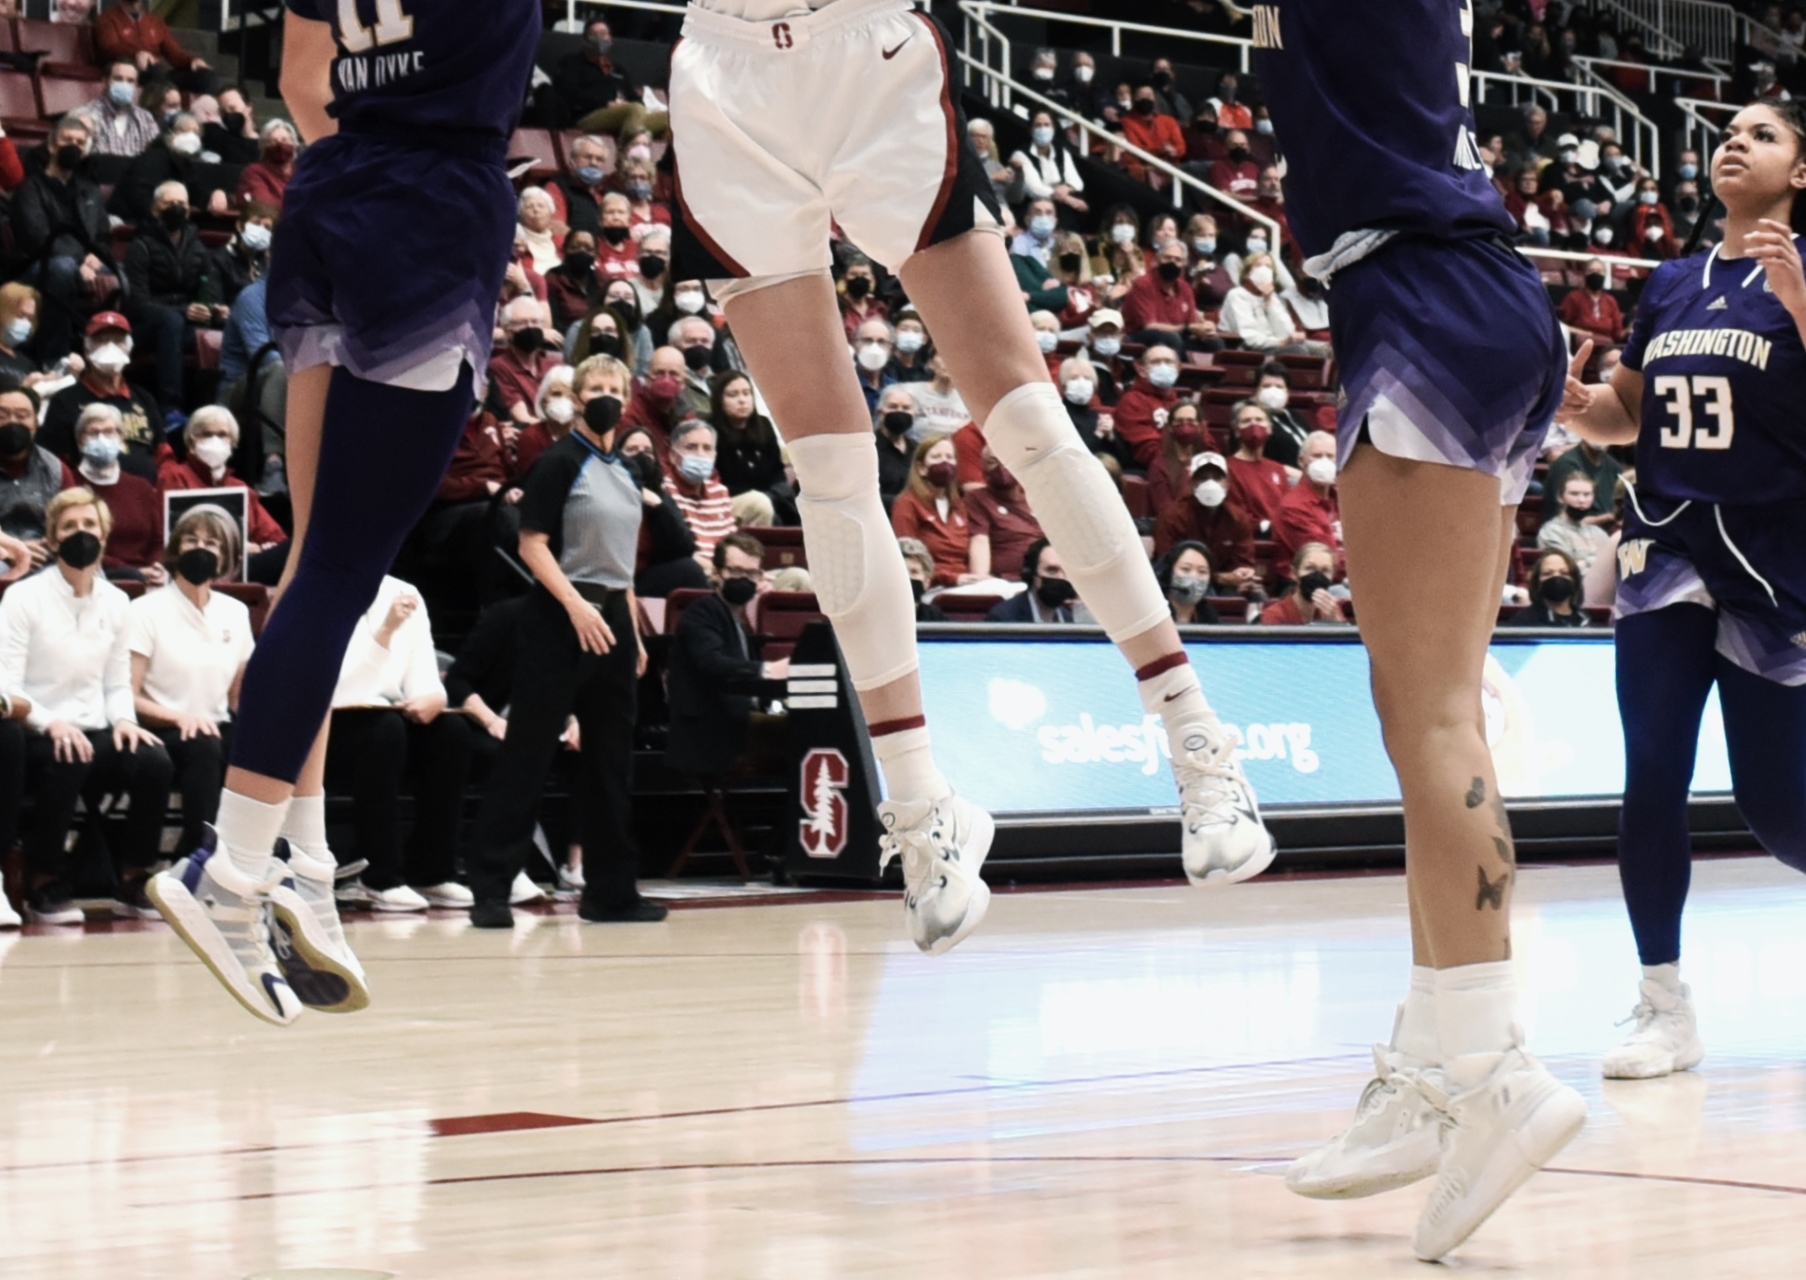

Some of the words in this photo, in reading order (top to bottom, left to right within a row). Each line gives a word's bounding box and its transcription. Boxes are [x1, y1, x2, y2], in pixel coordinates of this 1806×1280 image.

[1642, 328, 1773, 371] WASHINGTON
[1654, 375, 1734, 449] 33
[1617, 539, 1656, 580] W
